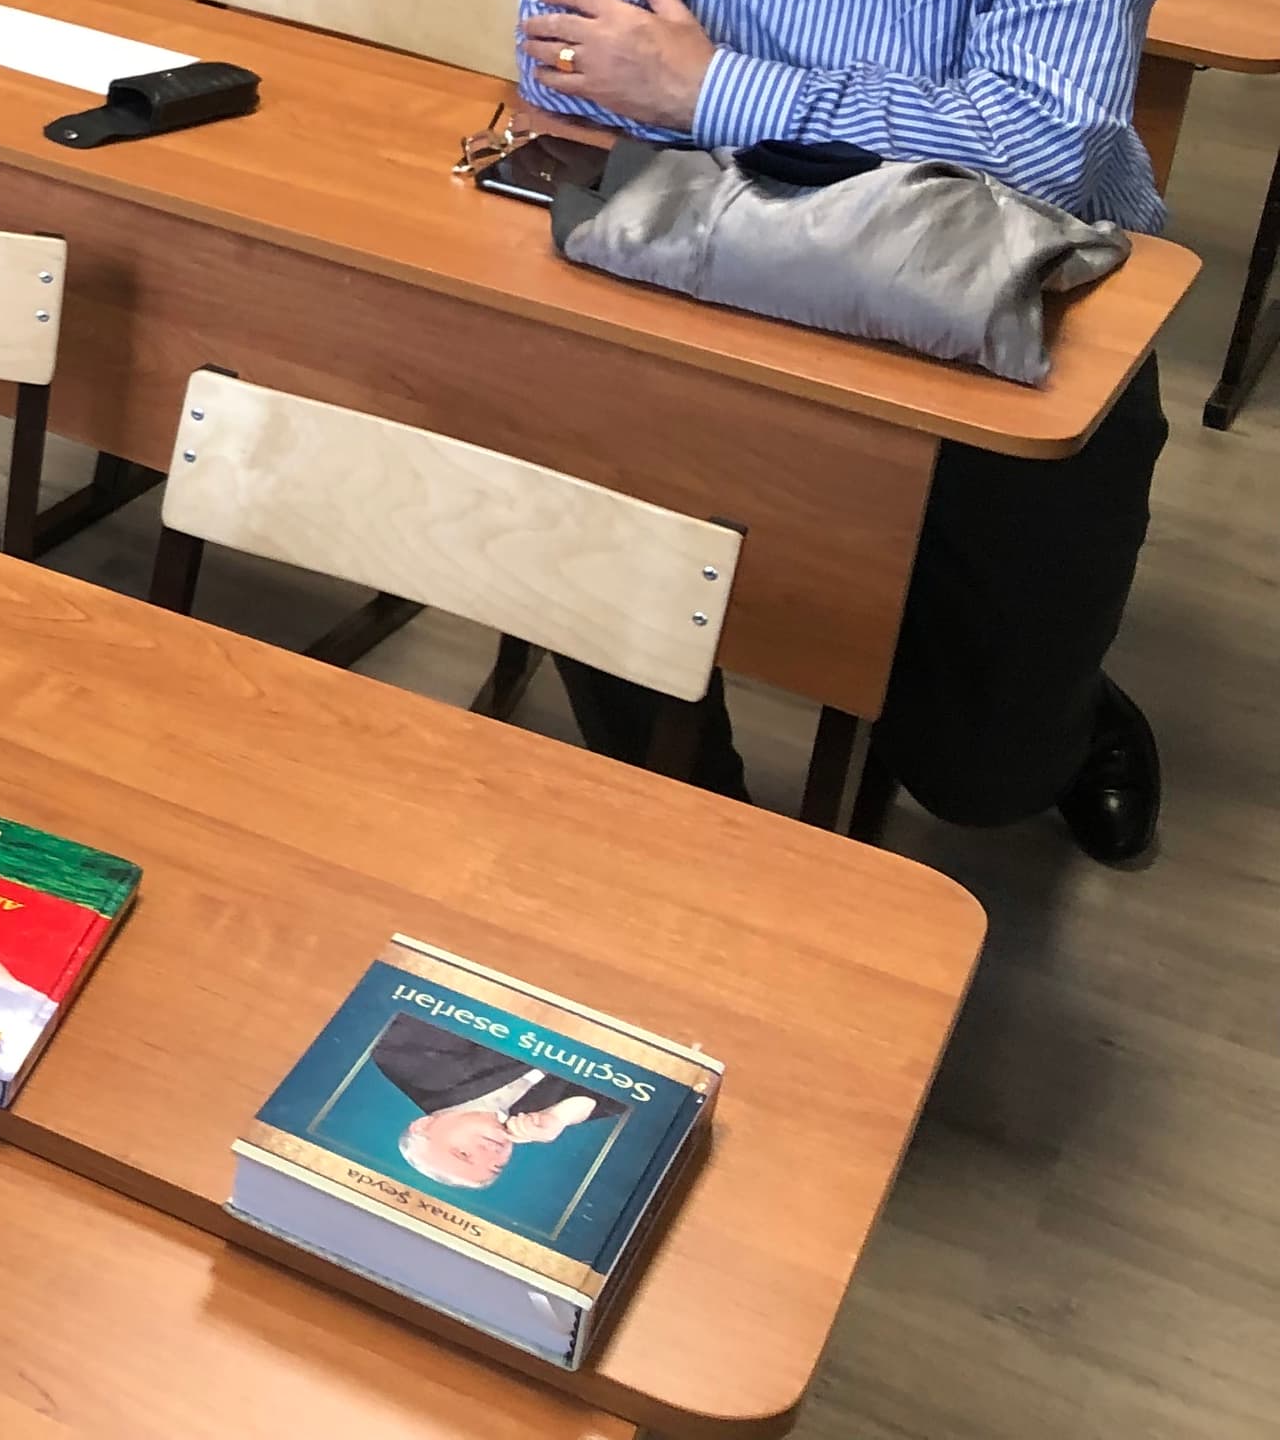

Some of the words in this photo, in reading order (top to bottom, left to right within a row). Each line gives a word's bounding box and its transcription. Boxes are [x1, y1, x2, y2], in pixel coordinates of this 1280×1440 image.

[388, 982, 512, 1043] əsərləri
[513, 1029, 659, 1103] Seçilmiş
[340, 1163, 418, 1207] Şeyda
[413, 1198, 486, 1238] Simax
